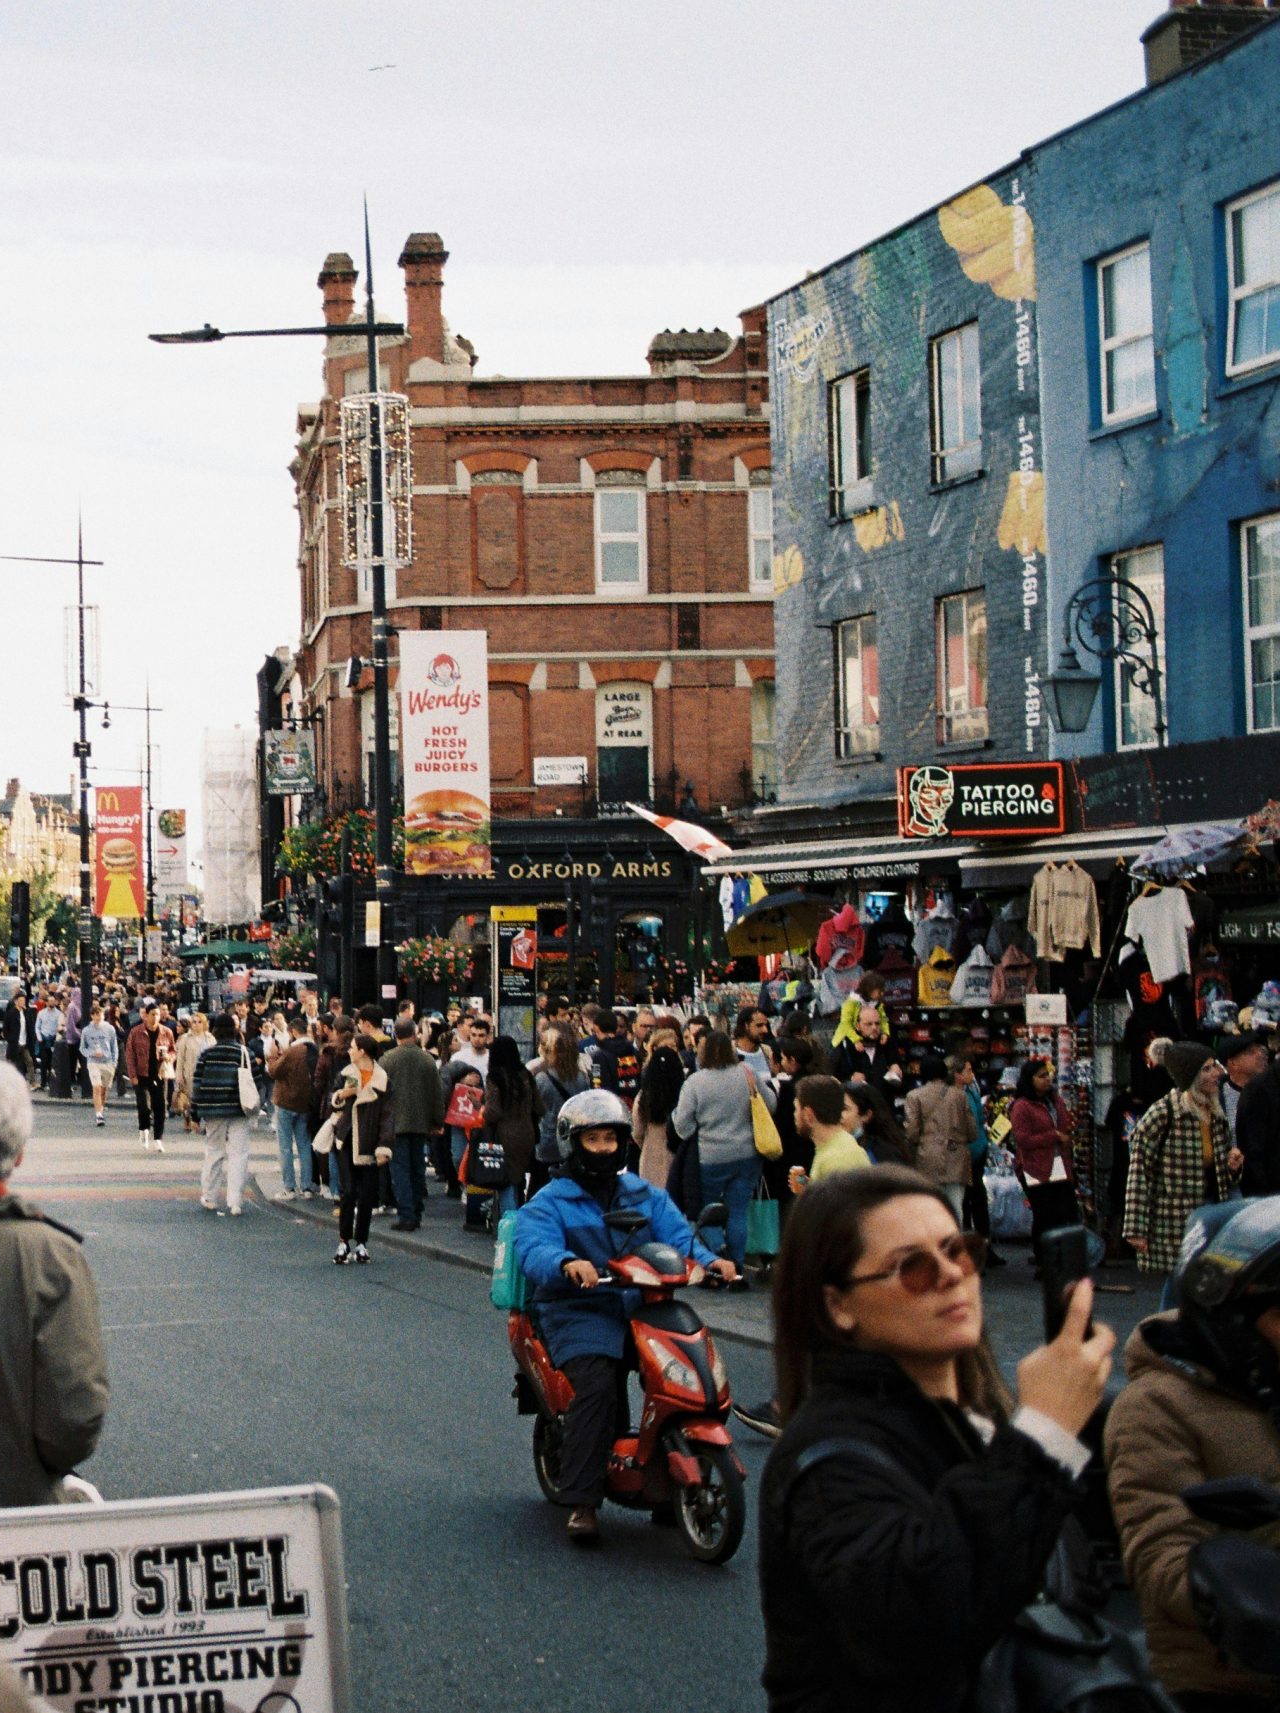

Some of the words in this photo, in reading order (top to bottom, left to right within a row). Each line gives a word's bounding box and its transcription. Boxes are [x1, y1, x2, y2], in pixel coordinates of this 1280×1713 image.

[1016, 311, 1031, 365] 1460
[1019, 430, 1034, 486] 1460
[1022, 552, 1038, 606] 1460
[408, 684, 481, 716] Wendy's
[605, 692, 641, 701] LARGE
[1025, 672, 1041, 727] 1460
[432, 726, 458, 735] HOT
[424, 739, 467, 748] FRESH
[426, 751, 466, 760] JUICY
[414, 763, 478, 772] BURGERS
[960, 784, 1035, 800] TATTOO
[1041, 783, 1055, 799] &
[961, 799, 1055, 816] PIERCING
[97, 814, 140, 826] Hungry?
[508, 863, 601, 879] OXFORD
[612, 862, 671, 878] ARMS
[813, 868, 848, 881] SOUVENIRS
[853, 865, 885, 879] CHILDREN
[885, 862, 920, 875] CLOTHING
[130, 1534, 310, 1620] STEEL
[86, 1624, 165, 1640] Established
[171, 1620, 206, 1634] 1993
[108, 1645, 303, 1691] PIERCING
